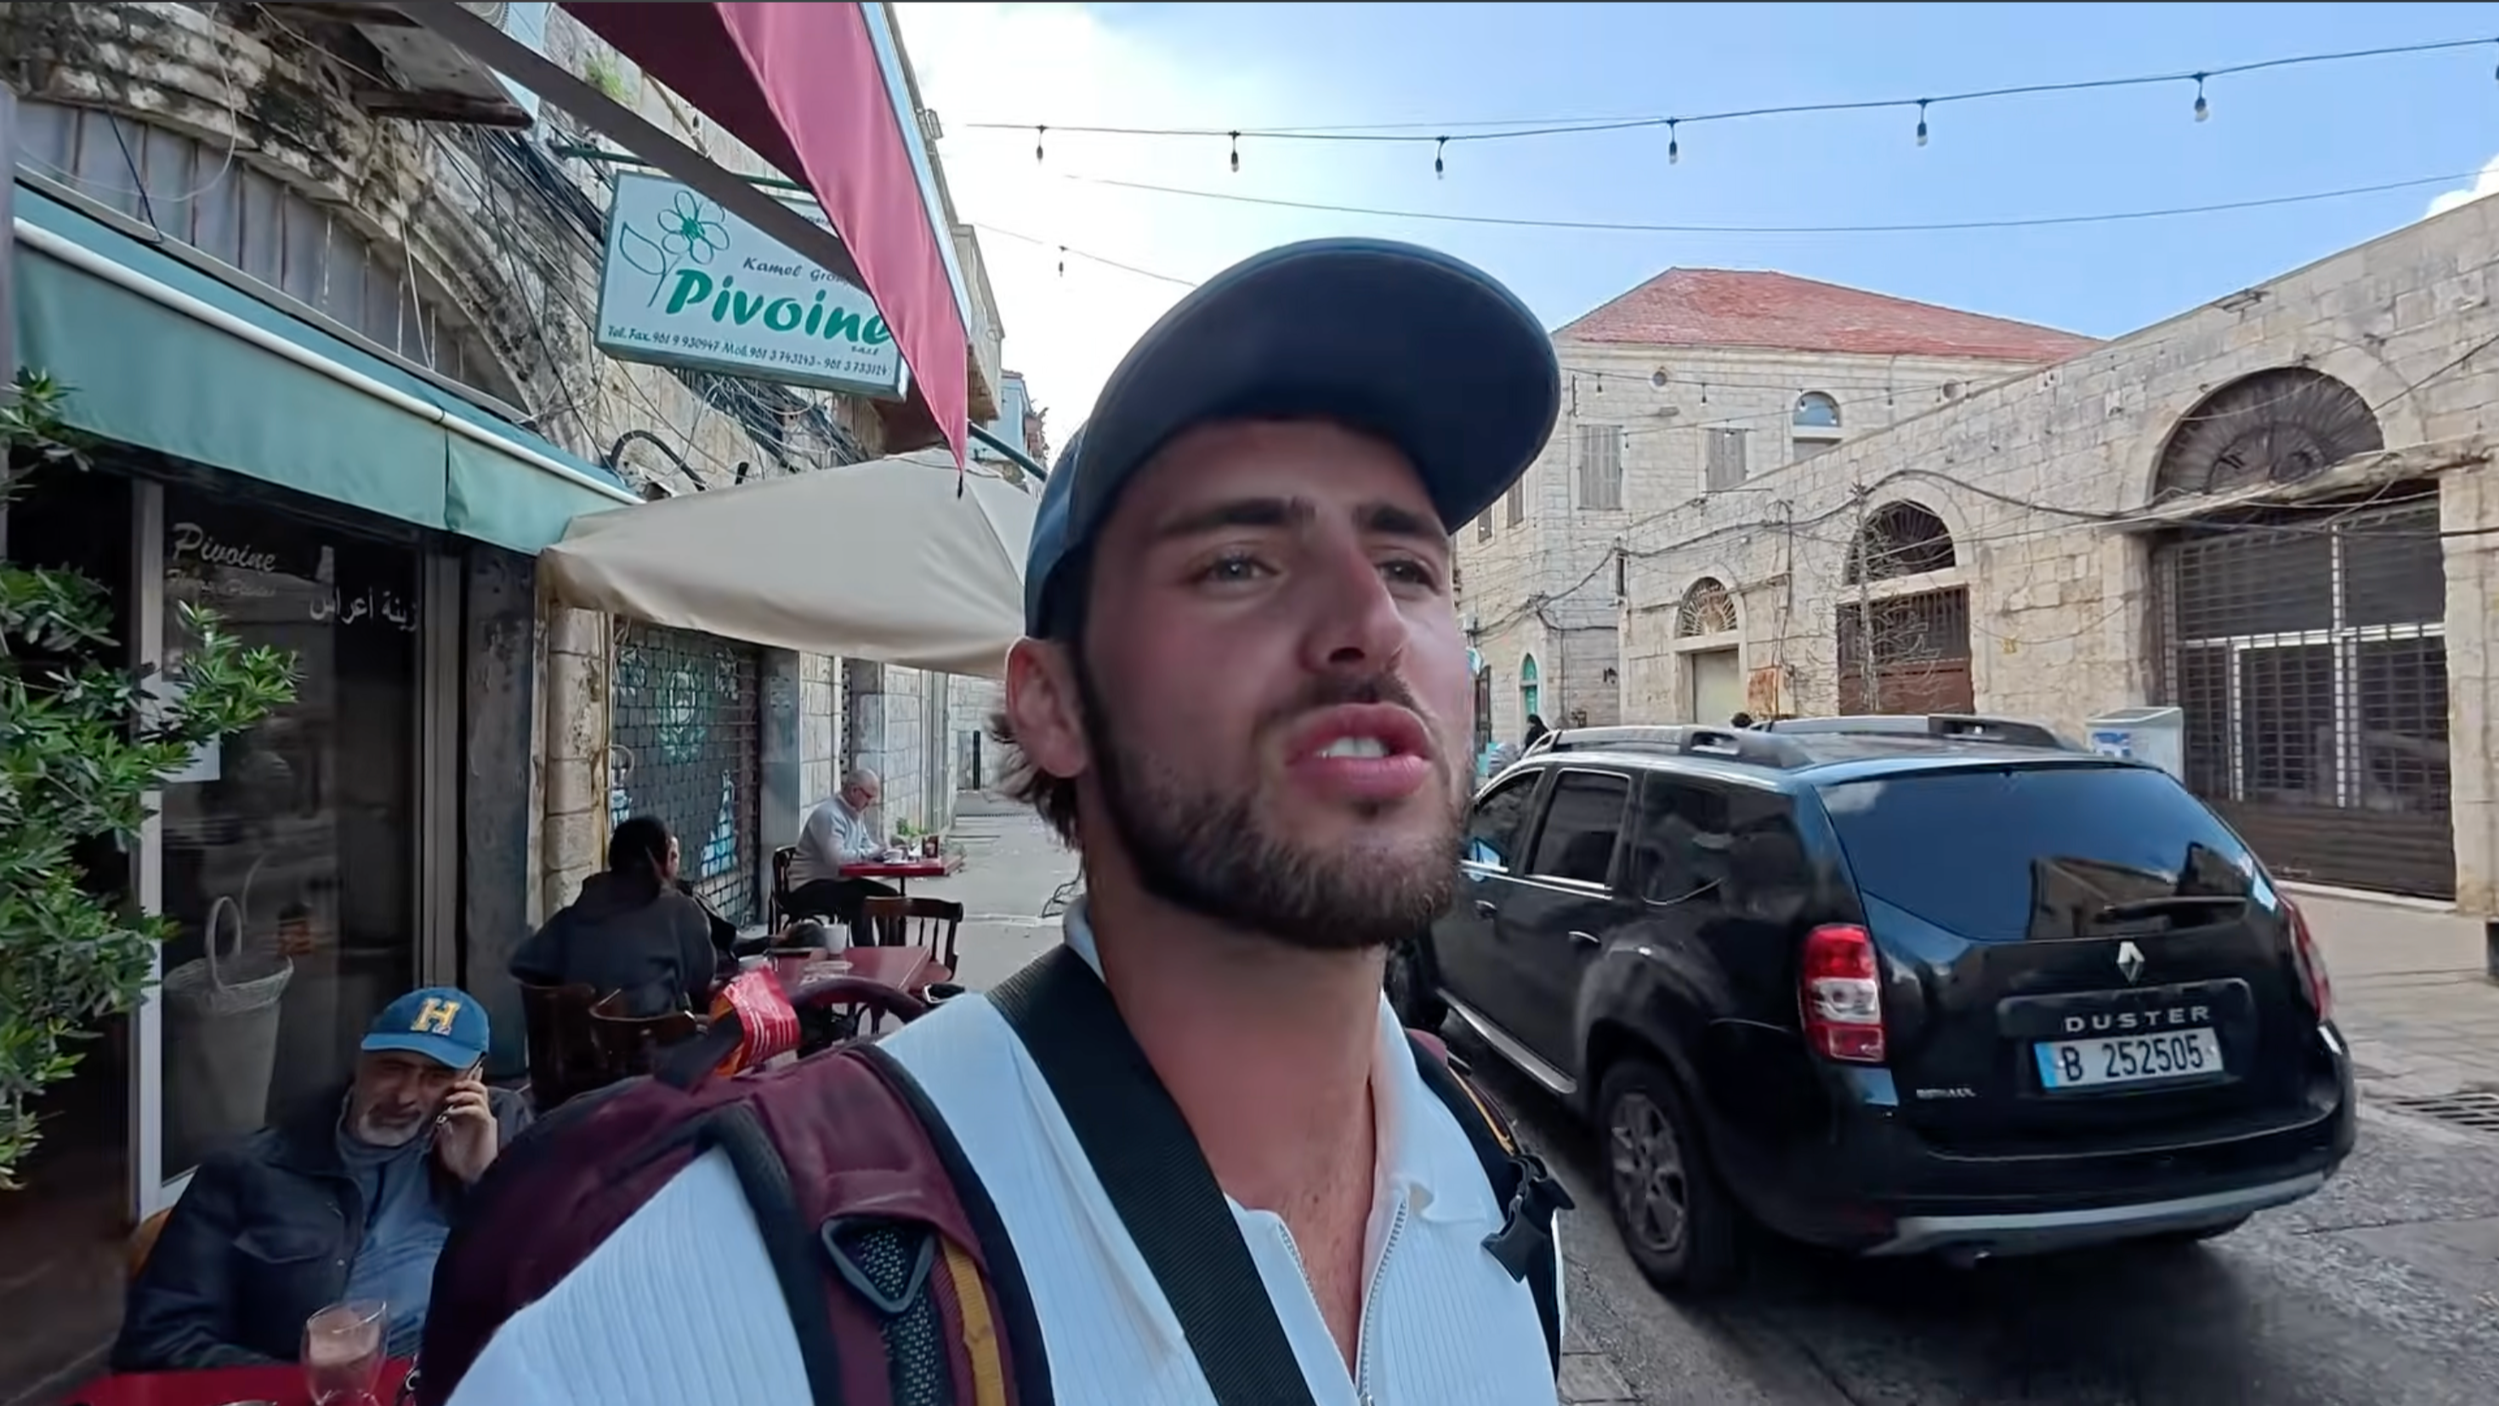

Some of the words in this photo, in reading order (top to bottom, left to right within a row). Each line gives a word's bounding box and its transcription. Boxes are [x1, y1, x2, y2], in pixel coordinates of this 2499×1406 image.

[743, 257, 802, 277] Kamel
[666, 269, 892, 345] Pivoine
[673, 335, 681, 346] 9
[769, 350, 777, 361] 3
[844, 360, 851, 371] 3
[172, 521, 277, 572] Pivoine
[410, 997, 460, 1036] H
[2063, 1005, 2211, 1033] DUSTER
[2061, 1045, 2084, 1082] B
[2102, 1034, 2204, 1079] 252505
